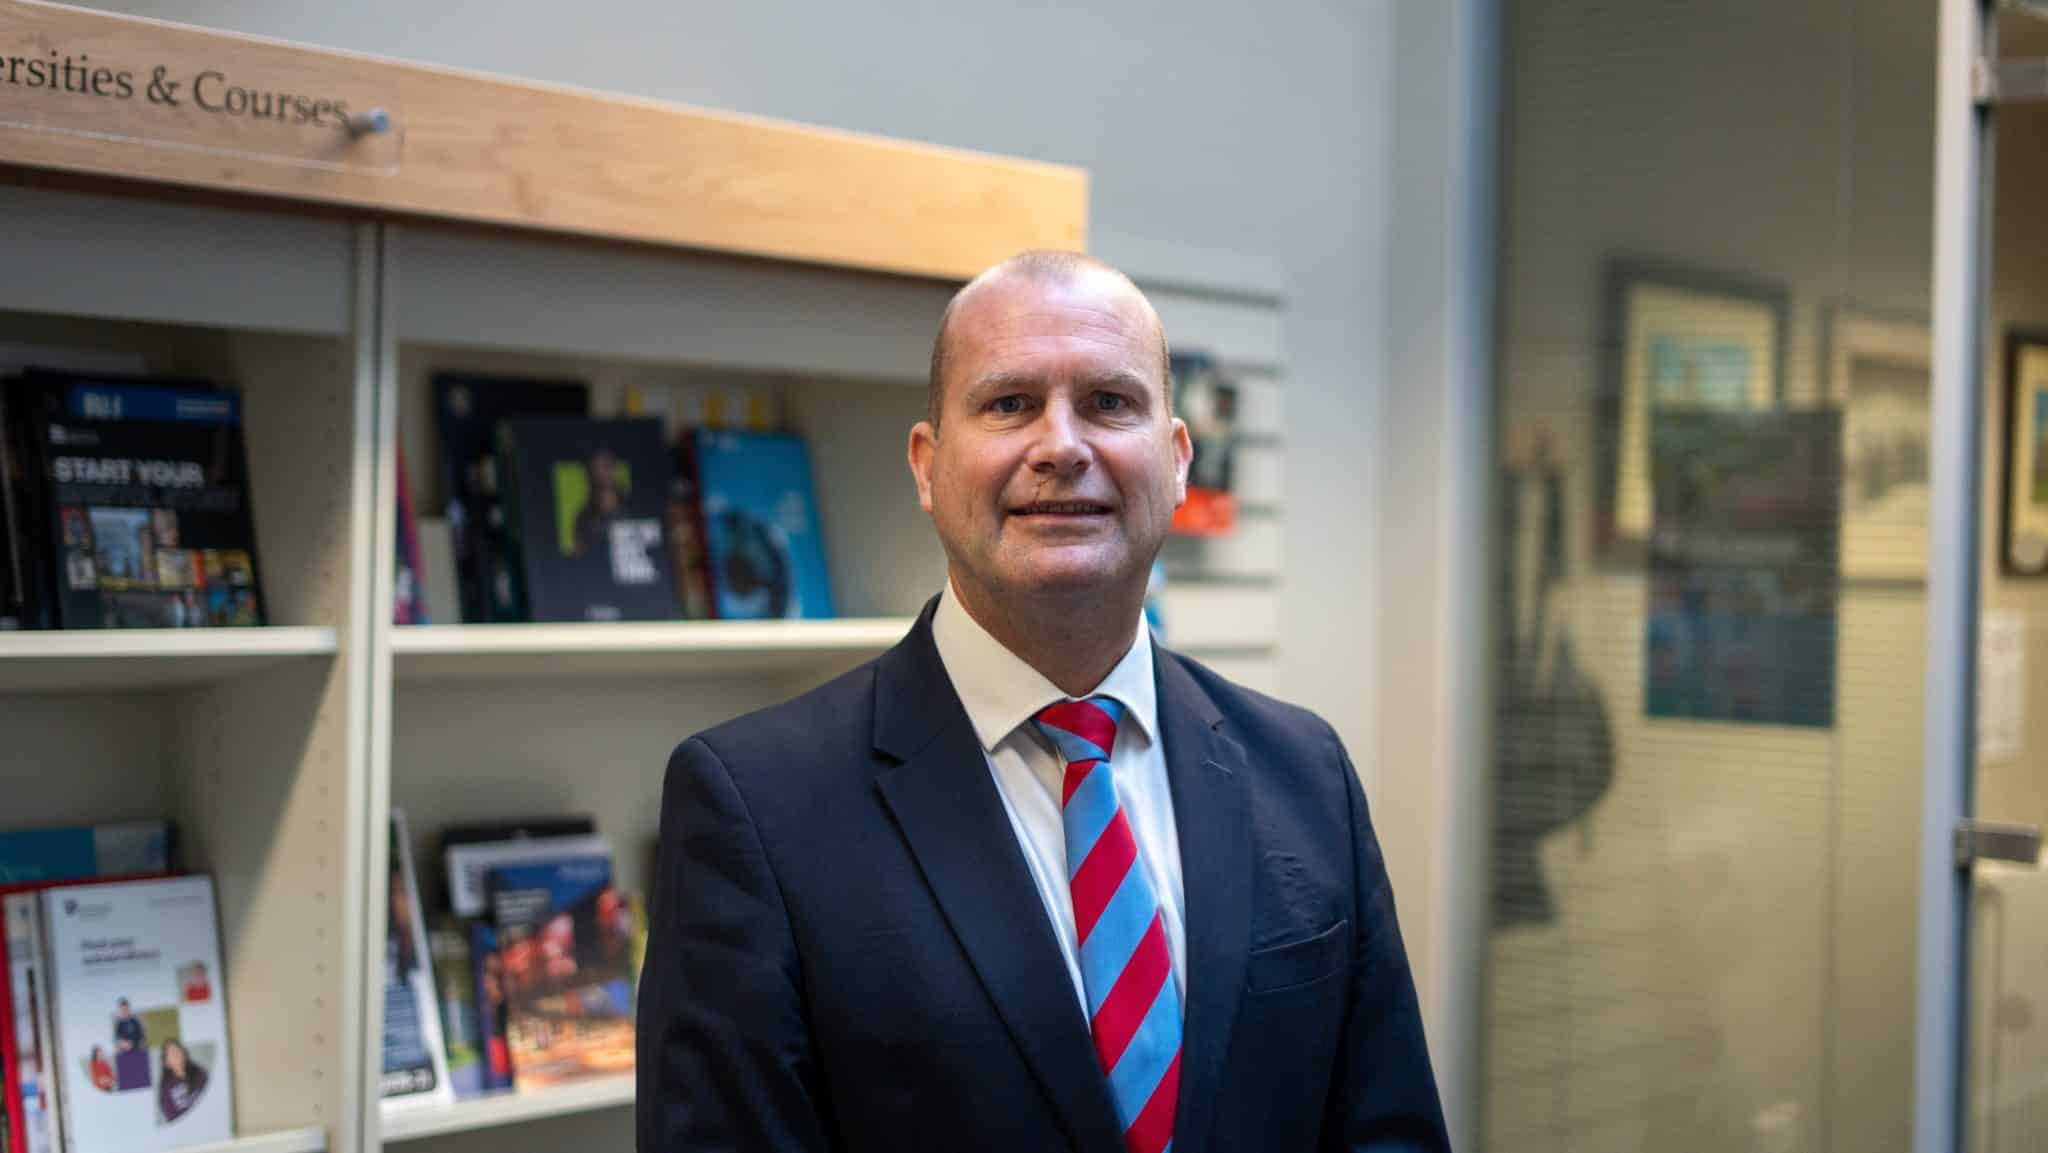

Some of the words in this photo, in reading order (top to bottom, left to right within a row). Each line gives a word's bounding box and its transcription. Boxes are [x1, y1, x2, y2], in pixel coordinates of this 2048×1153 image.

[0, 49, 134, 99] rsities
[146, 64, 181, 106] &
[193, 70, 350, 128] Courses
[54, 456, 131, 484] START
[137, 458, 204, 488] YOUR
